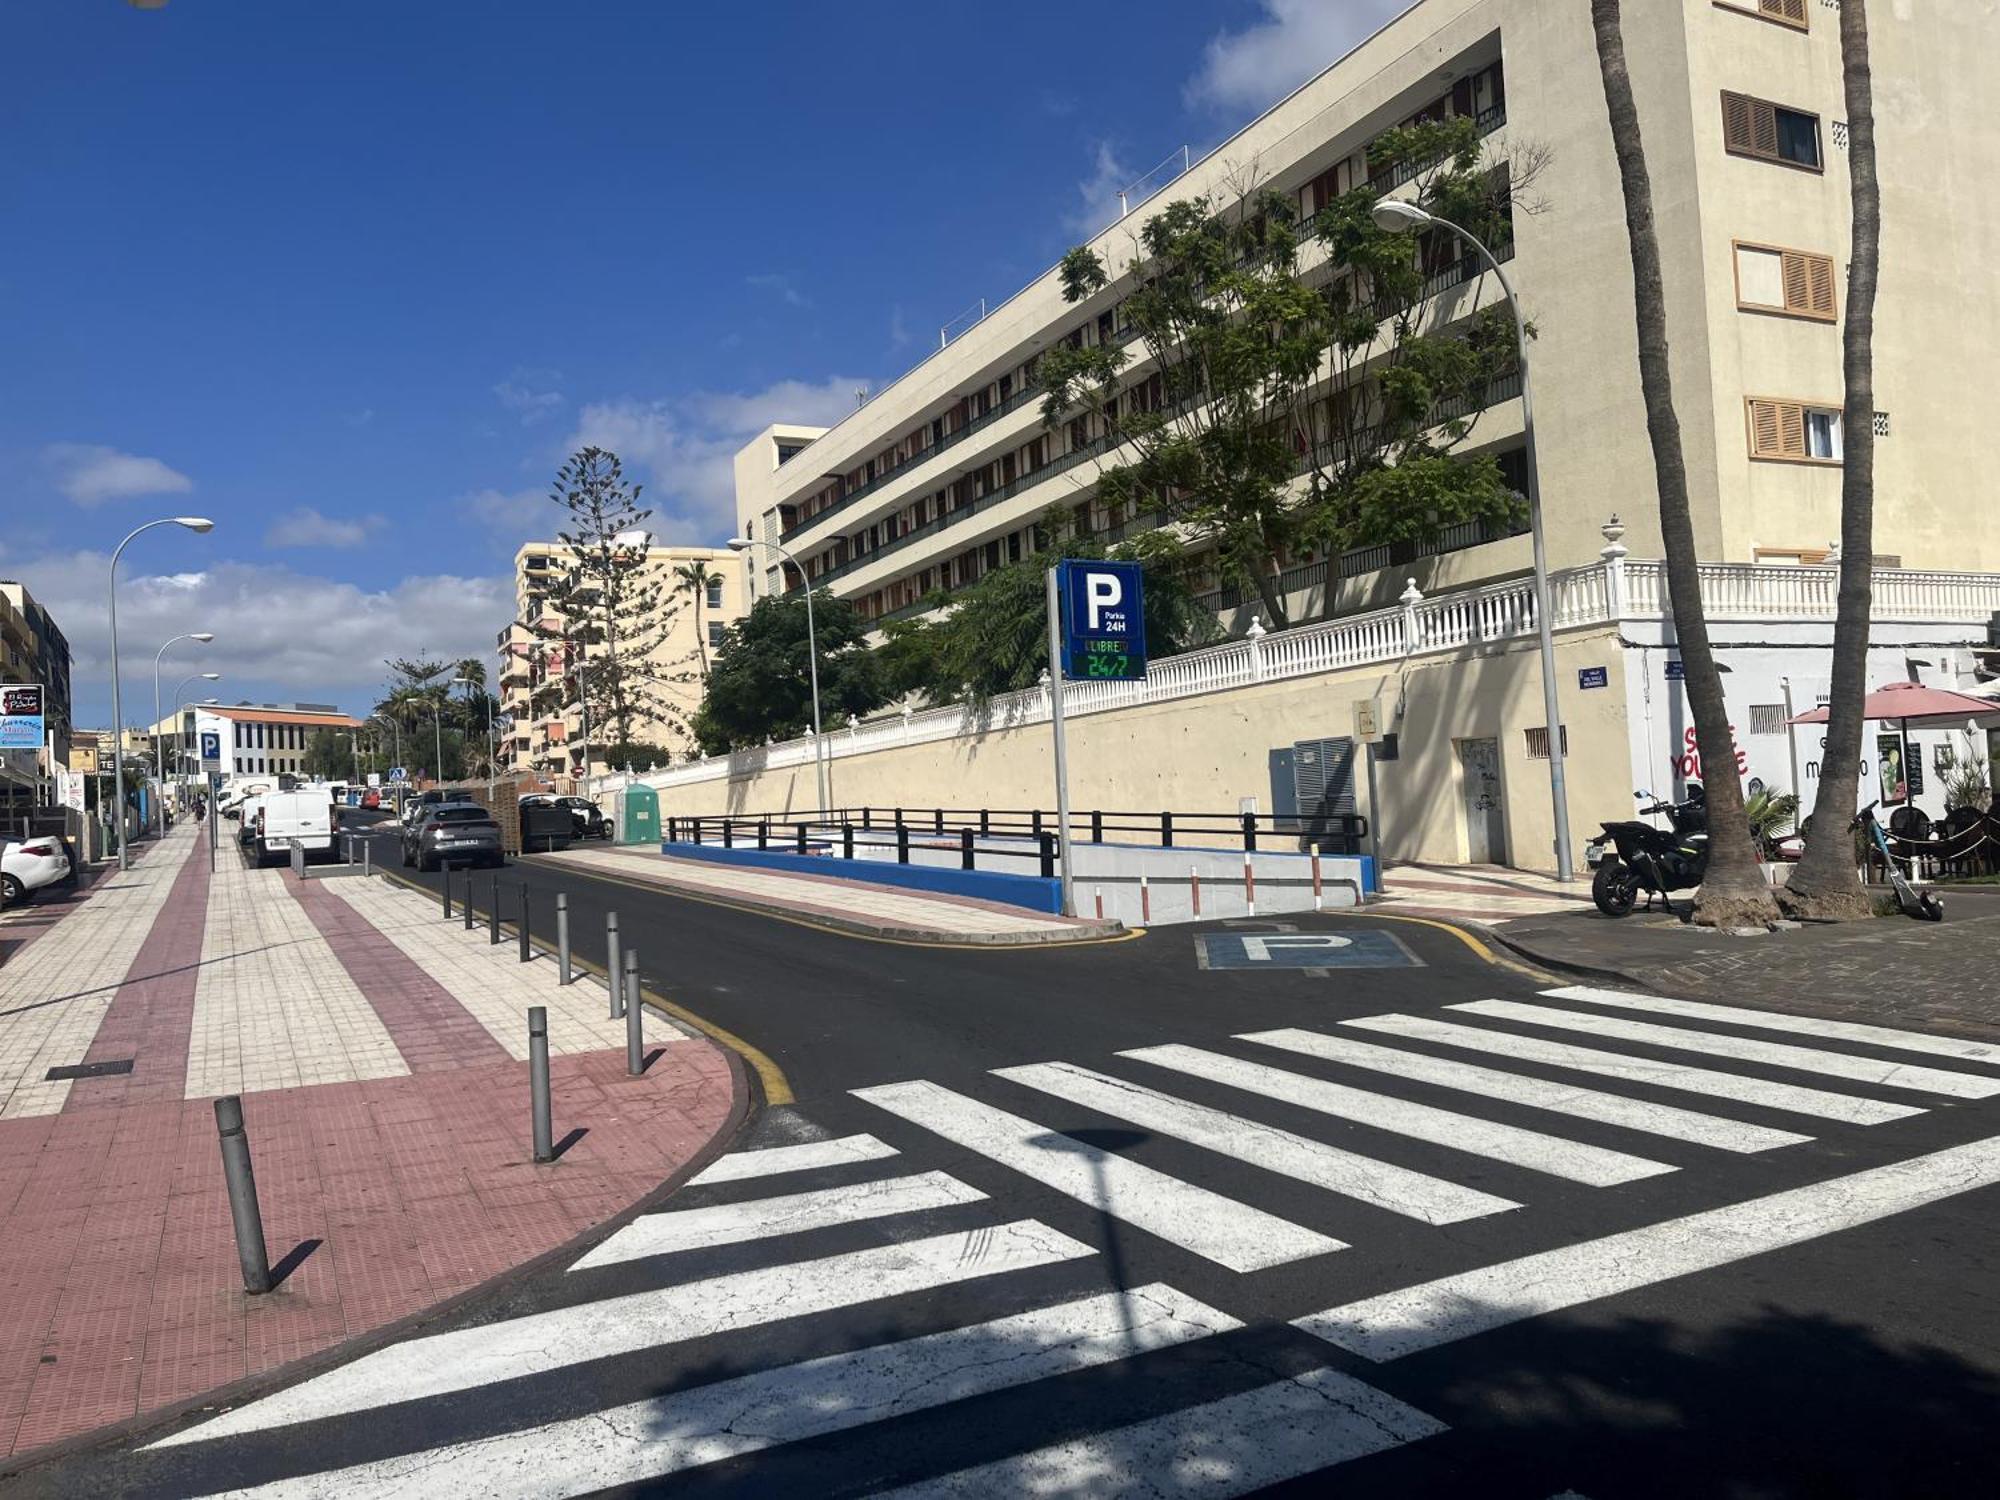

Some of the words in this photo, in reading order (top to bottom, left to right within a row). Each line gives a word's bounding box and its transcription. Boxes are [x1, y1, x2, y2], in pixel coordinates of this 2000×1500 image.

[1087, 573, 1122, 628] P
[1106, 621, 1126, 632] 24H
[1091, 641, 1120, 652] LIBRE
[205, 736, 216, 756] P
[1241, 936, 1353, 961] P
